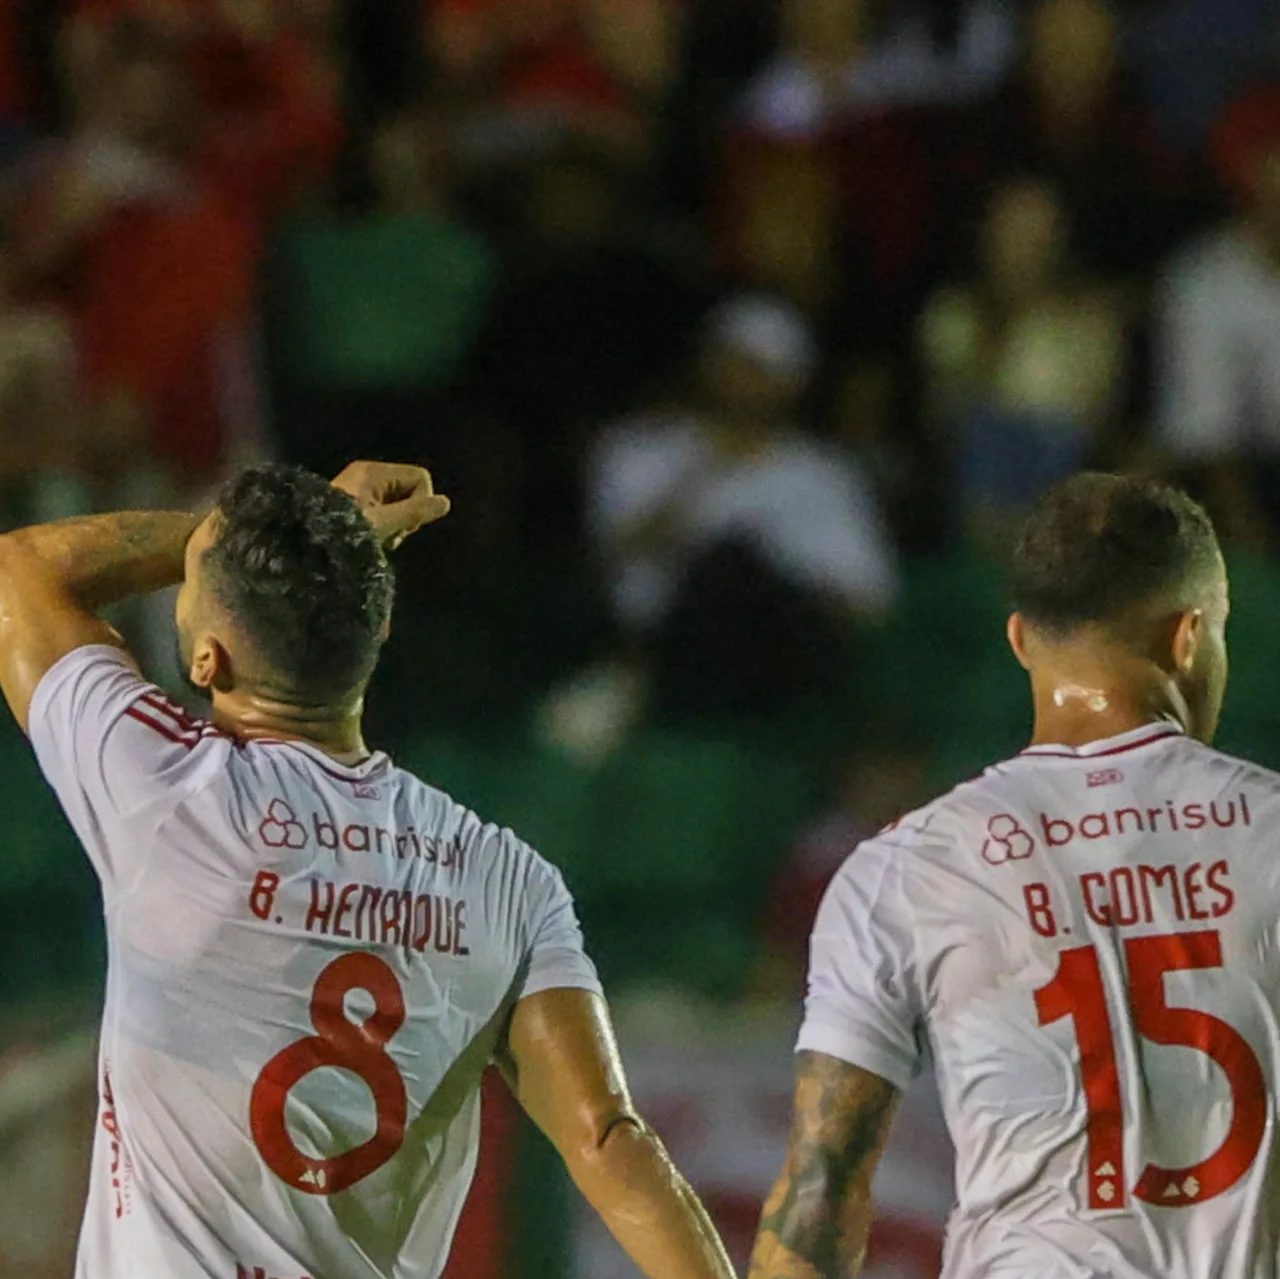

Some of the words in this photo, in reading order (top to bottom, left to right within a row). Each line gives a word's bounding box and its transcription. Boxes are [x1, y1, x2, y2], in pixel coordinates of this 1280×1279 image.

[313, 812, 466, 871] banrisul
[1041, 793, 1251, 848] banrisul
[249, 871, 283, 924] B.
[306, 878, 470, 956] HENRIQUE
[1024, 883, 1072, 937] B.
[1081, 860, 1234, 927] GOMES
[250, 951, 407, 1196] 8
[1033, 930, 1268, 1210] 15
